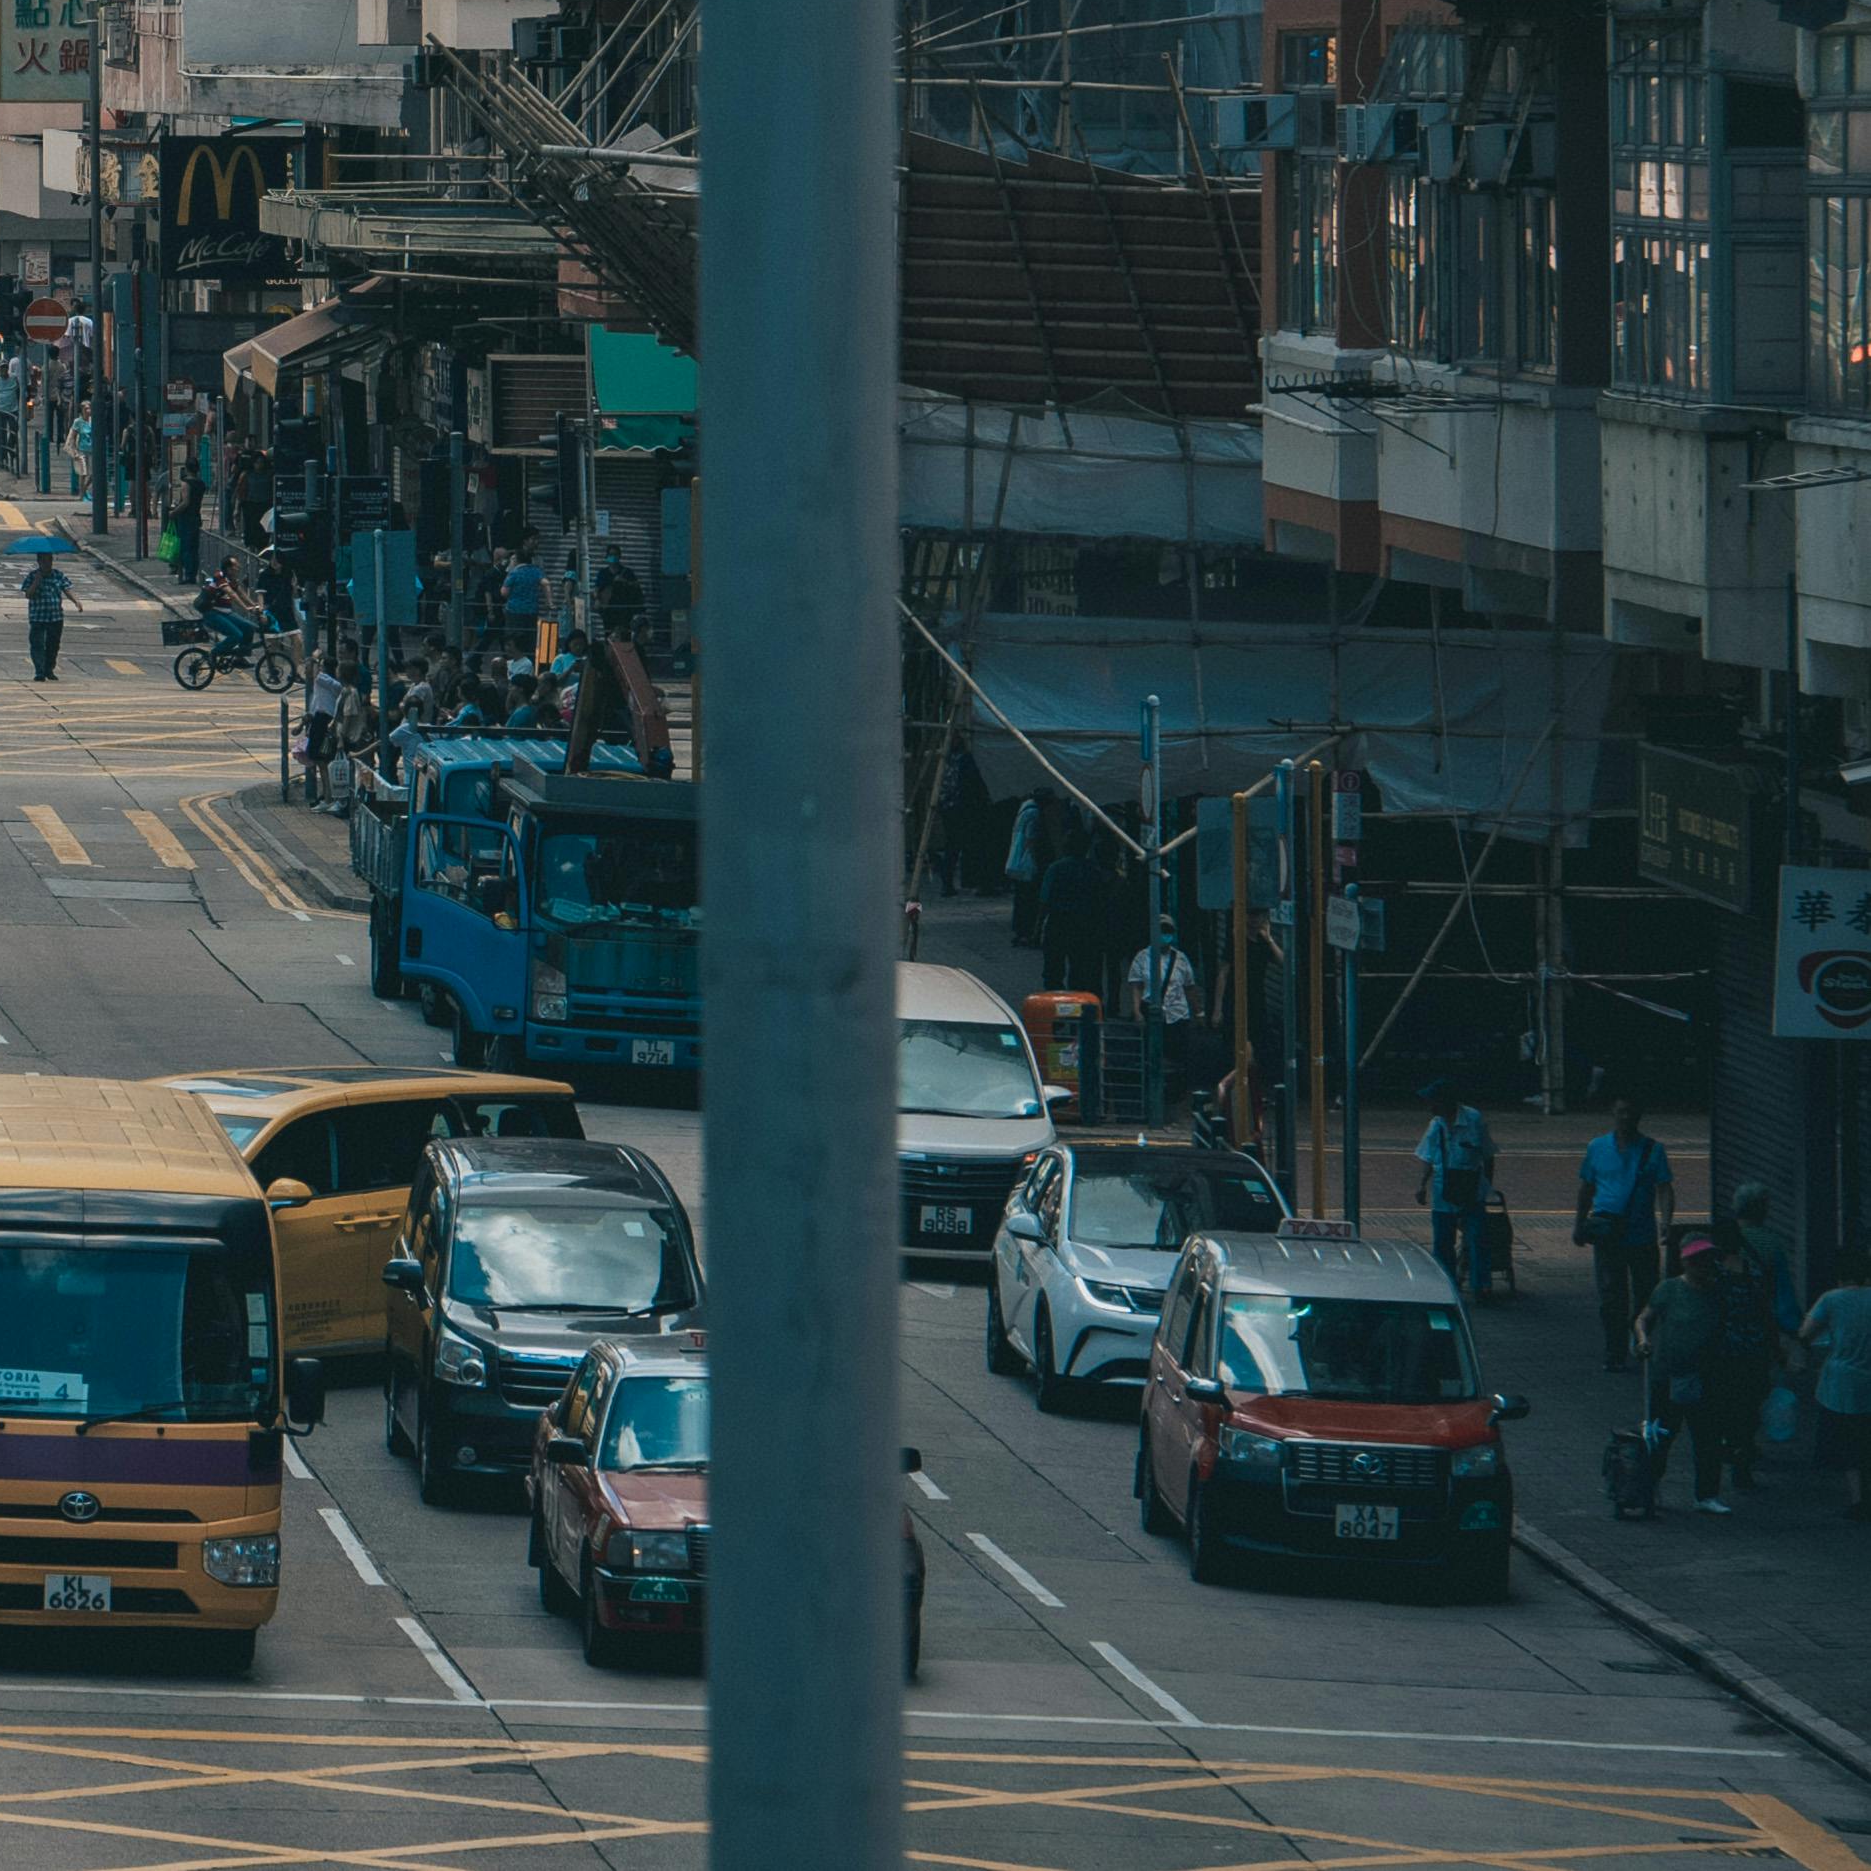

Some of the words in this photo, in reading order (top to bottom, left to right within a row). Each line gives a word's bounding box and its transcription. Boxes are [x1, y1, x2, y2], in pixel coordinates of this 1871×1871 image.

[934, 1205, 959, 1221] RS
[923, 1218, 969, 1234] 9098
[1288, 1220, 1353, 1239] TAXI
[54, 1382, 70, 1400] 4
[1353, 1506, 1380, 1522] XA
[1338, 1520, 1396, 1539] 8047
[62, 1576, 92, 1595] KL
[48, 1592, 106, 1611] 6626
